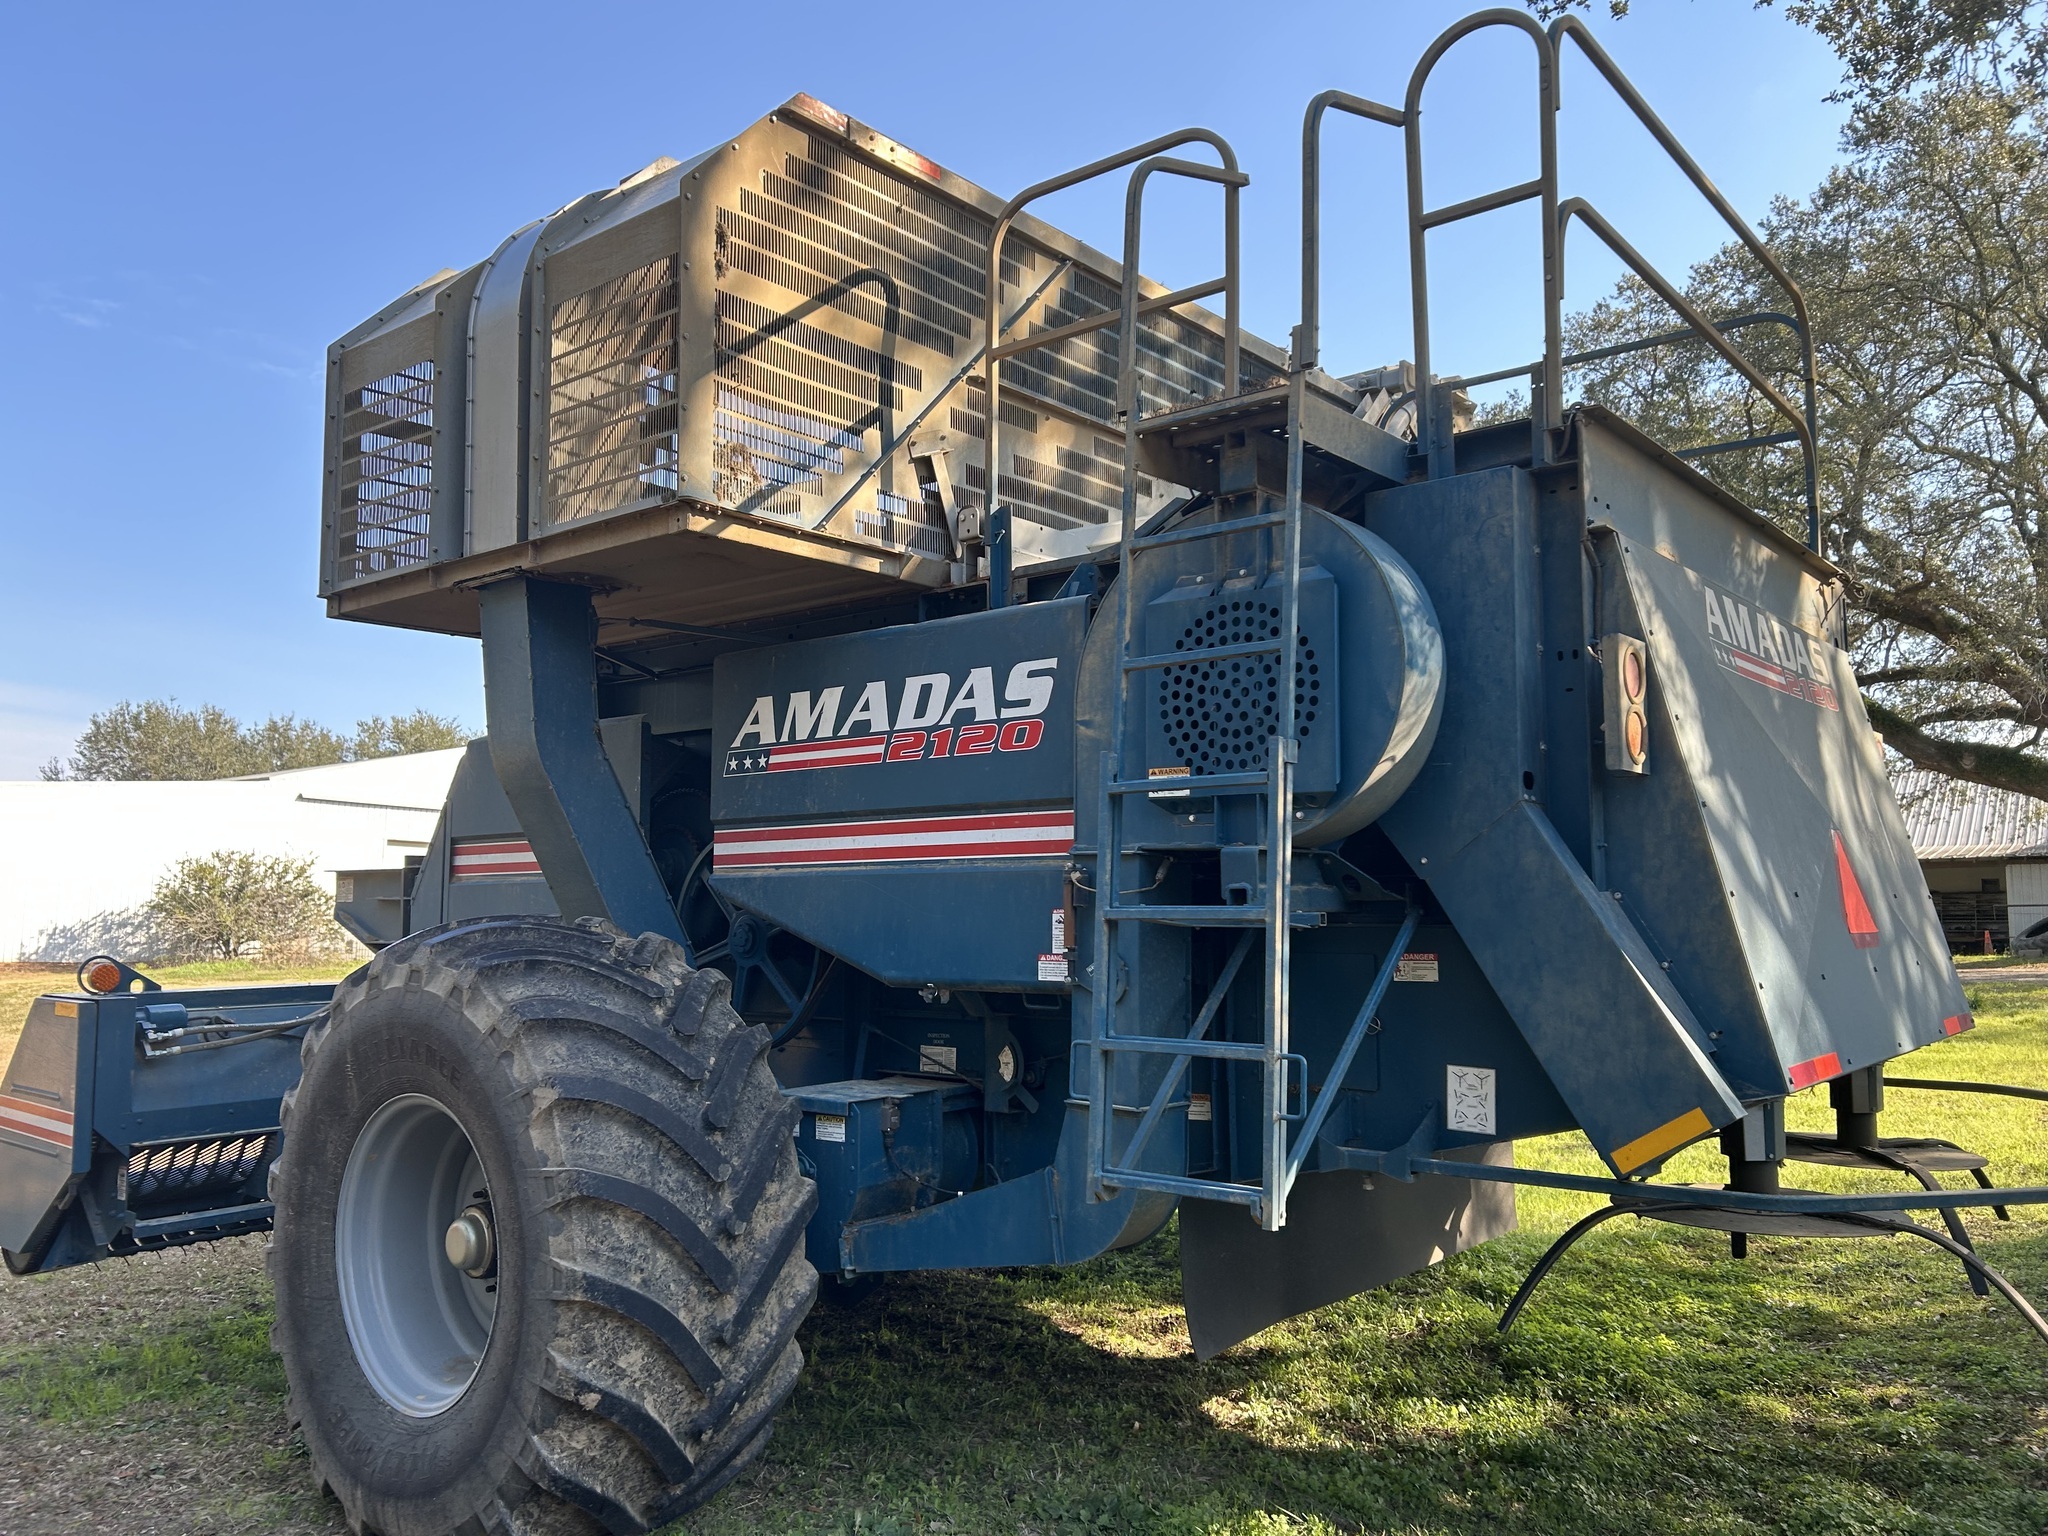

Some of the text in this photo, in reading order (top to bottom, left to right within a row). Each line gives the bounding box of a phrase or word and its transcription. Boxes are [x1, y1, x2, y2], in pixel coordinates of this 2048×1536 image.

[1704, 585, 1830, 686] AMADAS
[730, 657, 1058, 748] AMADAS
[1783, 669, 1839, 712] 2120
[885, 718, 1045, 763] 2120
[1158, 767, 1188, 775] WARNING
[1404, 953, 1435, 961] DANGER
[822, 1115, 844, 1123] CAUTION
